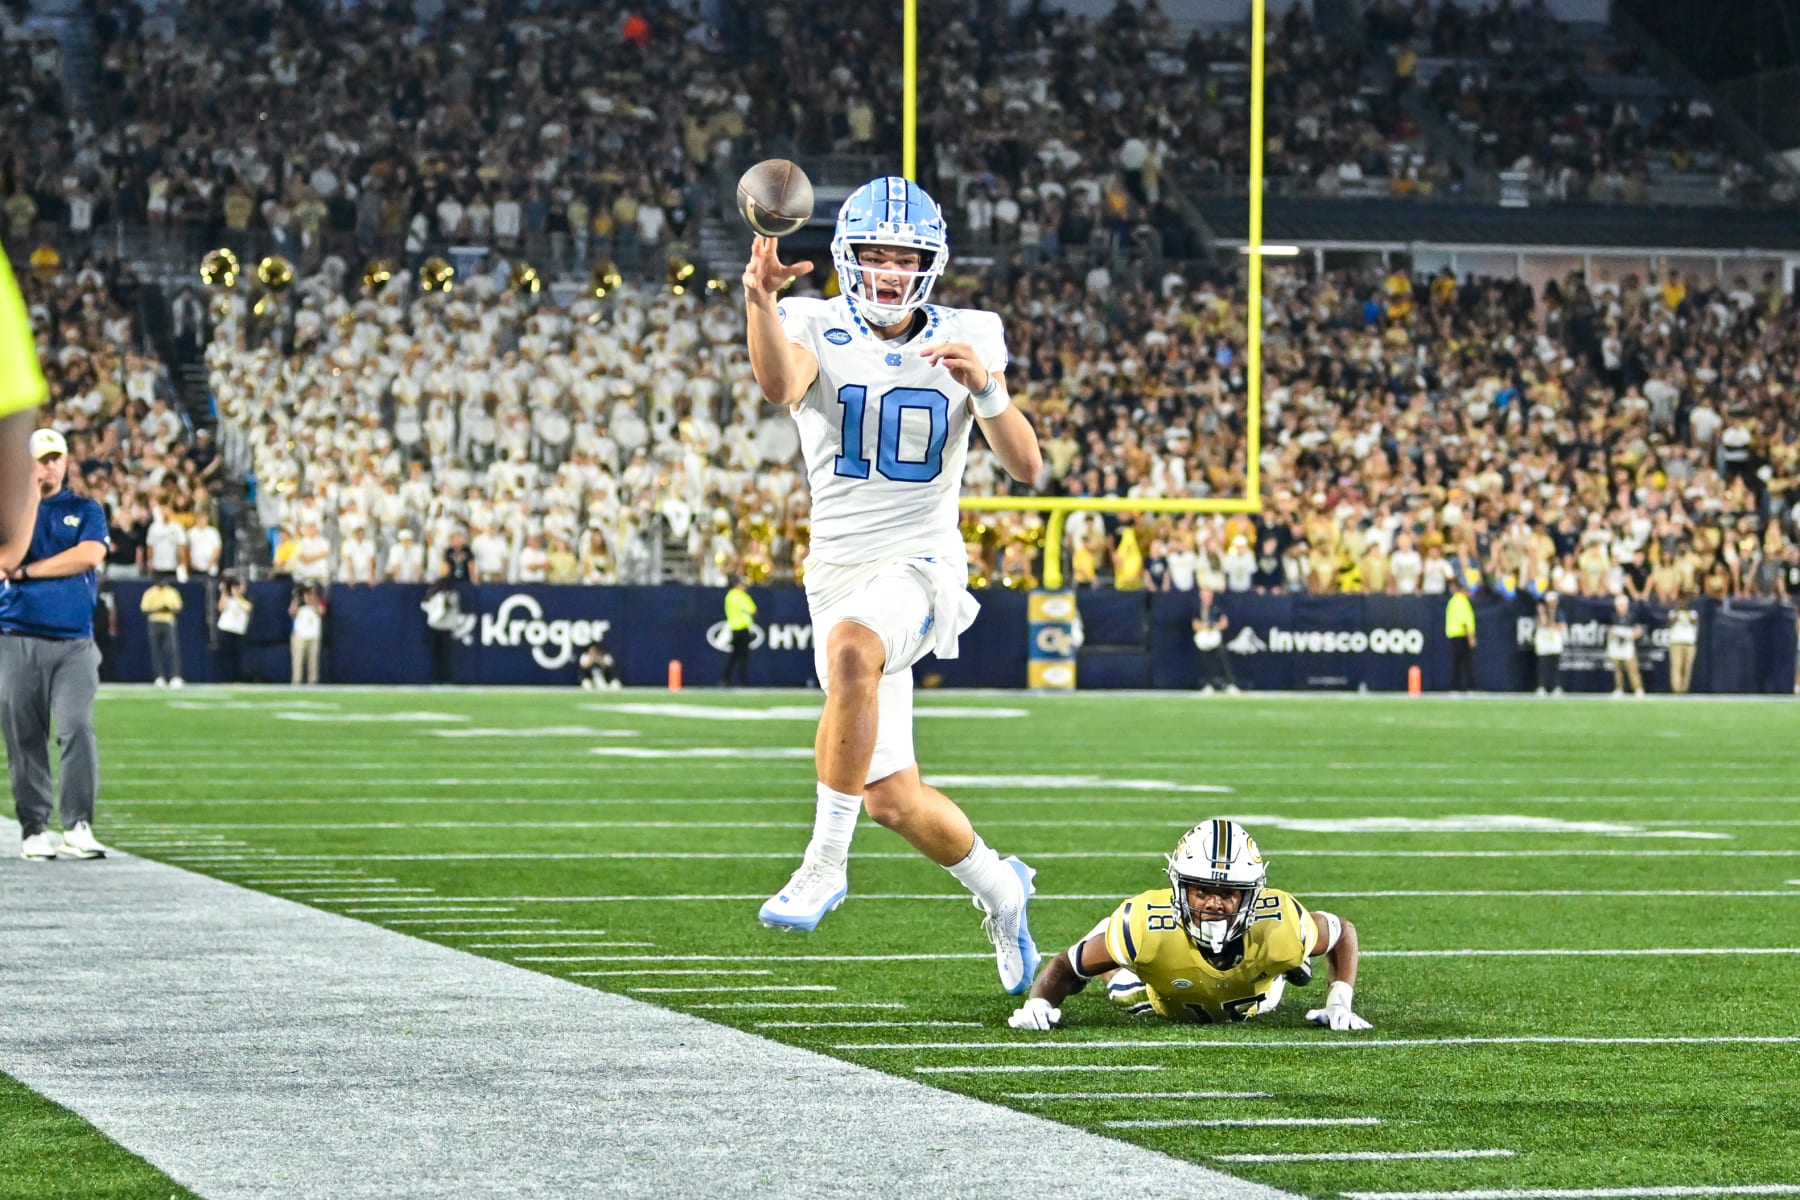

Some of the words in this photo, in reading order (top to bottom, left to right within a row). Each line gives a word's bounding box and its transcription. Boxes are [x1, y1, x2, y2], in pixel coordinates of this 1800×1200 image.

[834, 384, 949, 483] 10
[481, 594, 610, 669] Kroger
[1269, 626, 1368, 653] Invesco
[1211, 871, 1228, 881] TECH
[1147, 903, 1177, 930] 18
